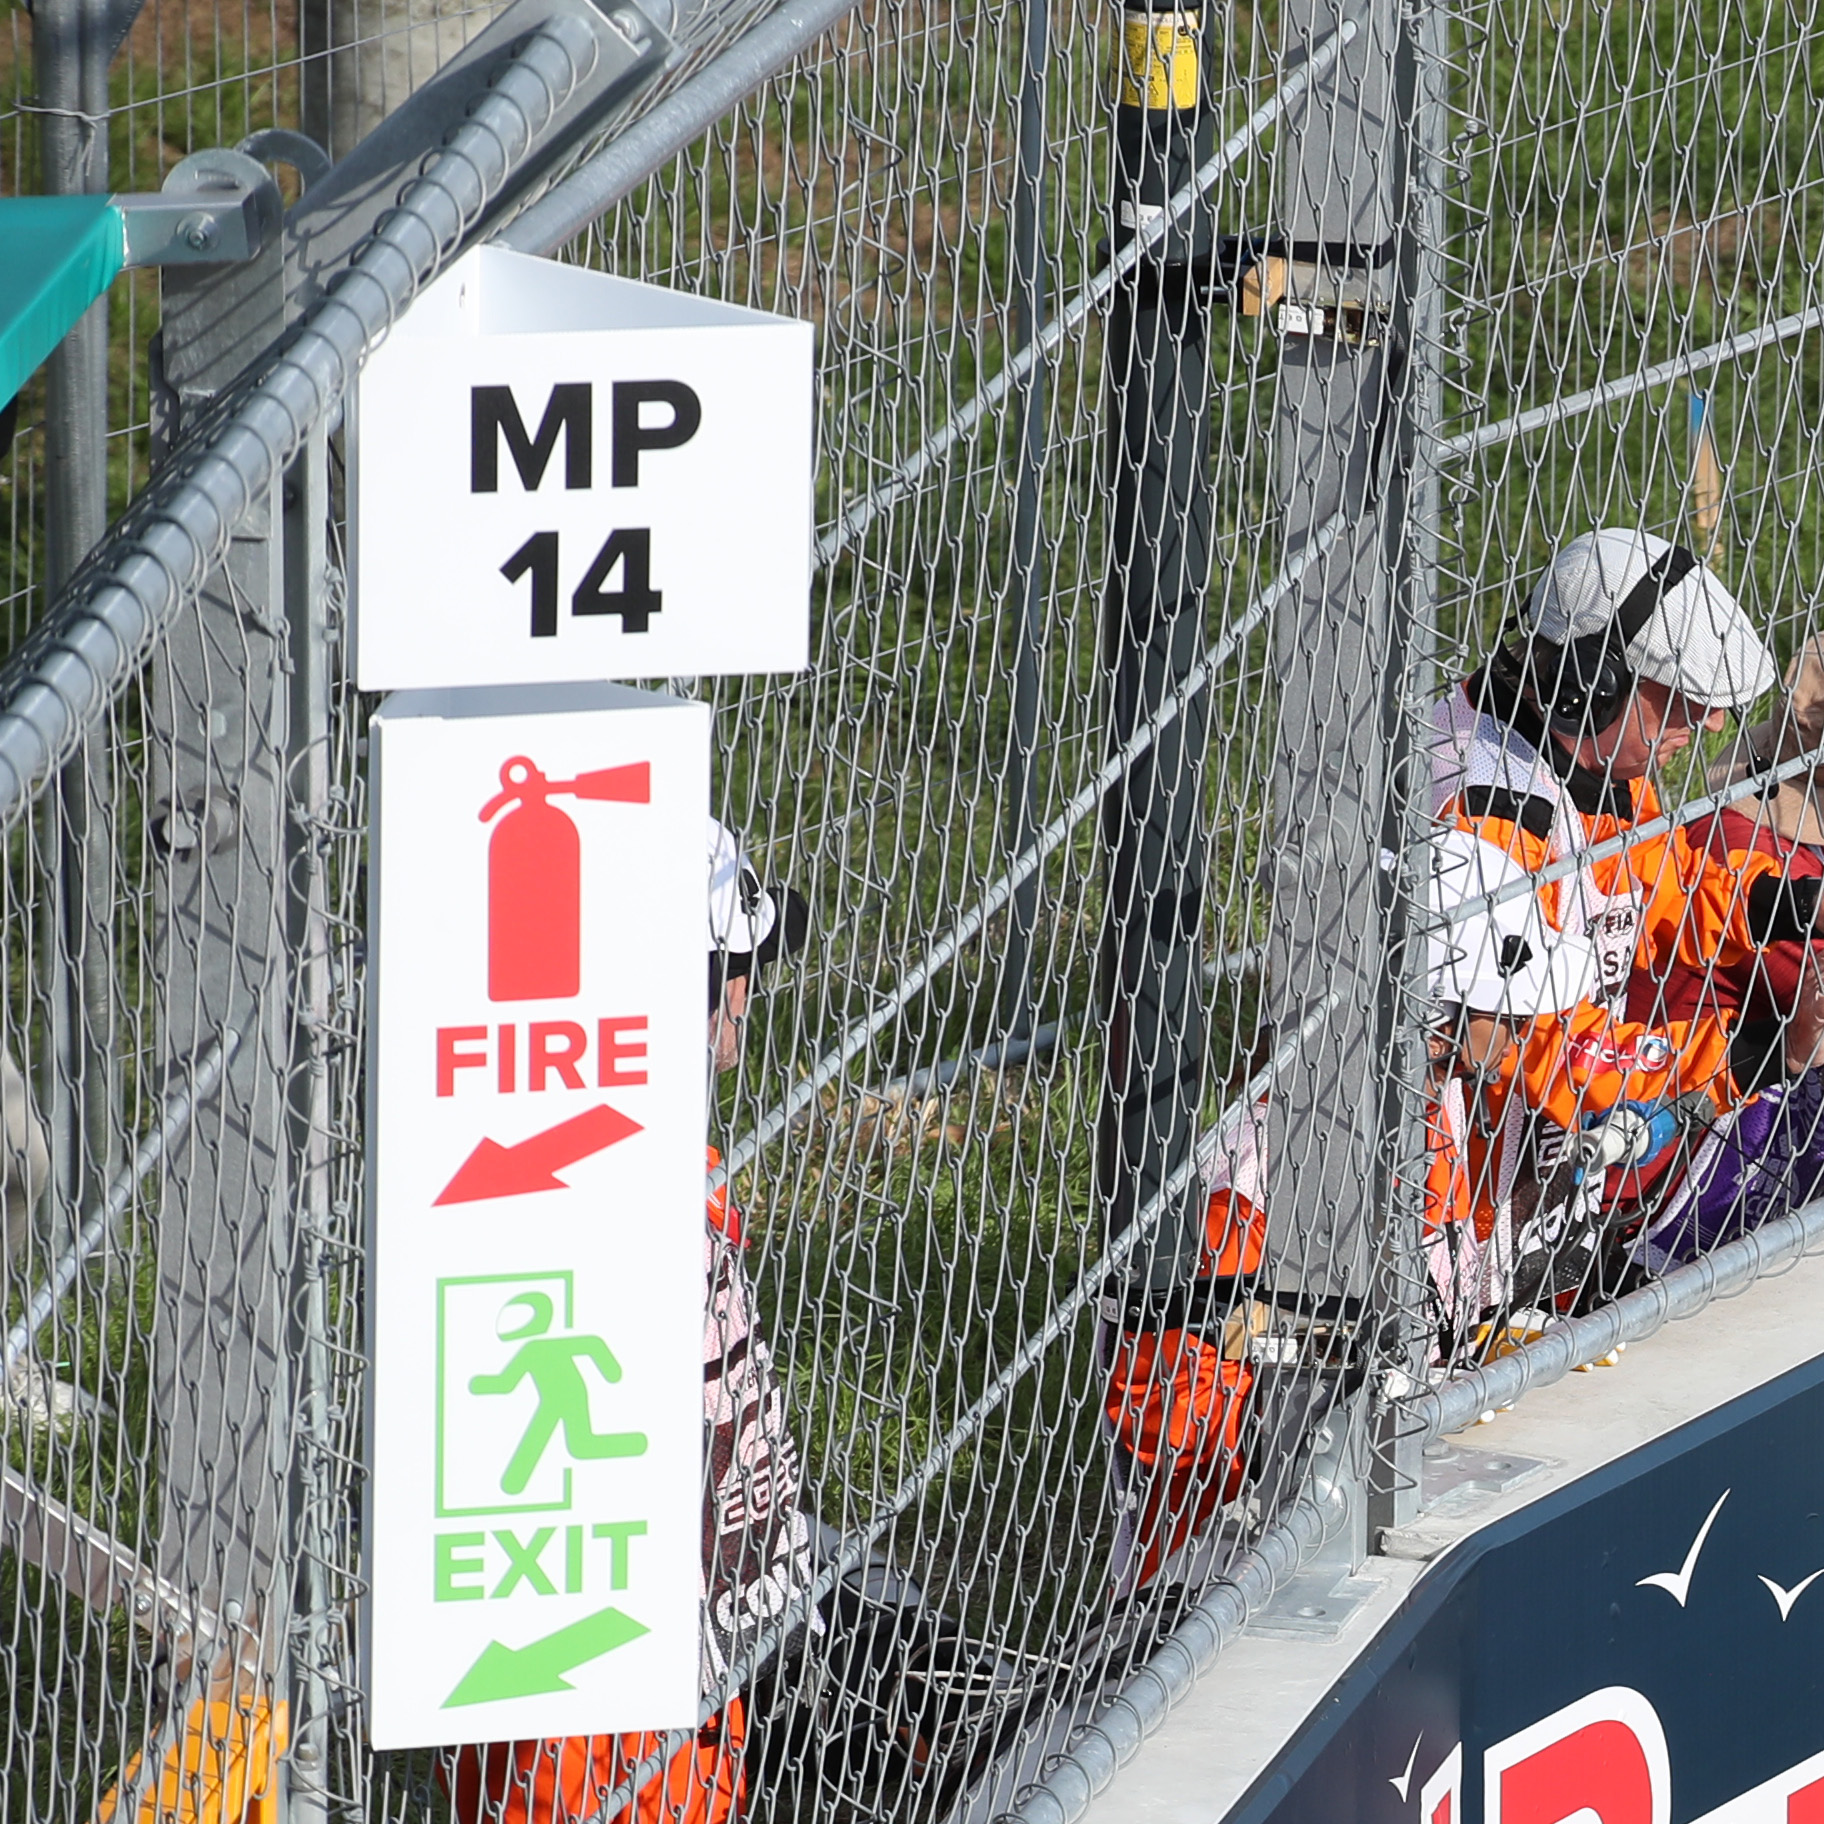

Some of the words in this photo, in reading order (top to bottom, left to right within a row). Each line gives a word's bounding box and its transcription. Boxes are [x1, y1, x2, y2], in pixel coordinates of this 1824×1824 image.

[470, 380, 703, 494] MP
[498, 529, 664, 639] 14
[436, 1016, 649, 1097] FIRE
[434, 1521, 648, 1602] EXIT
